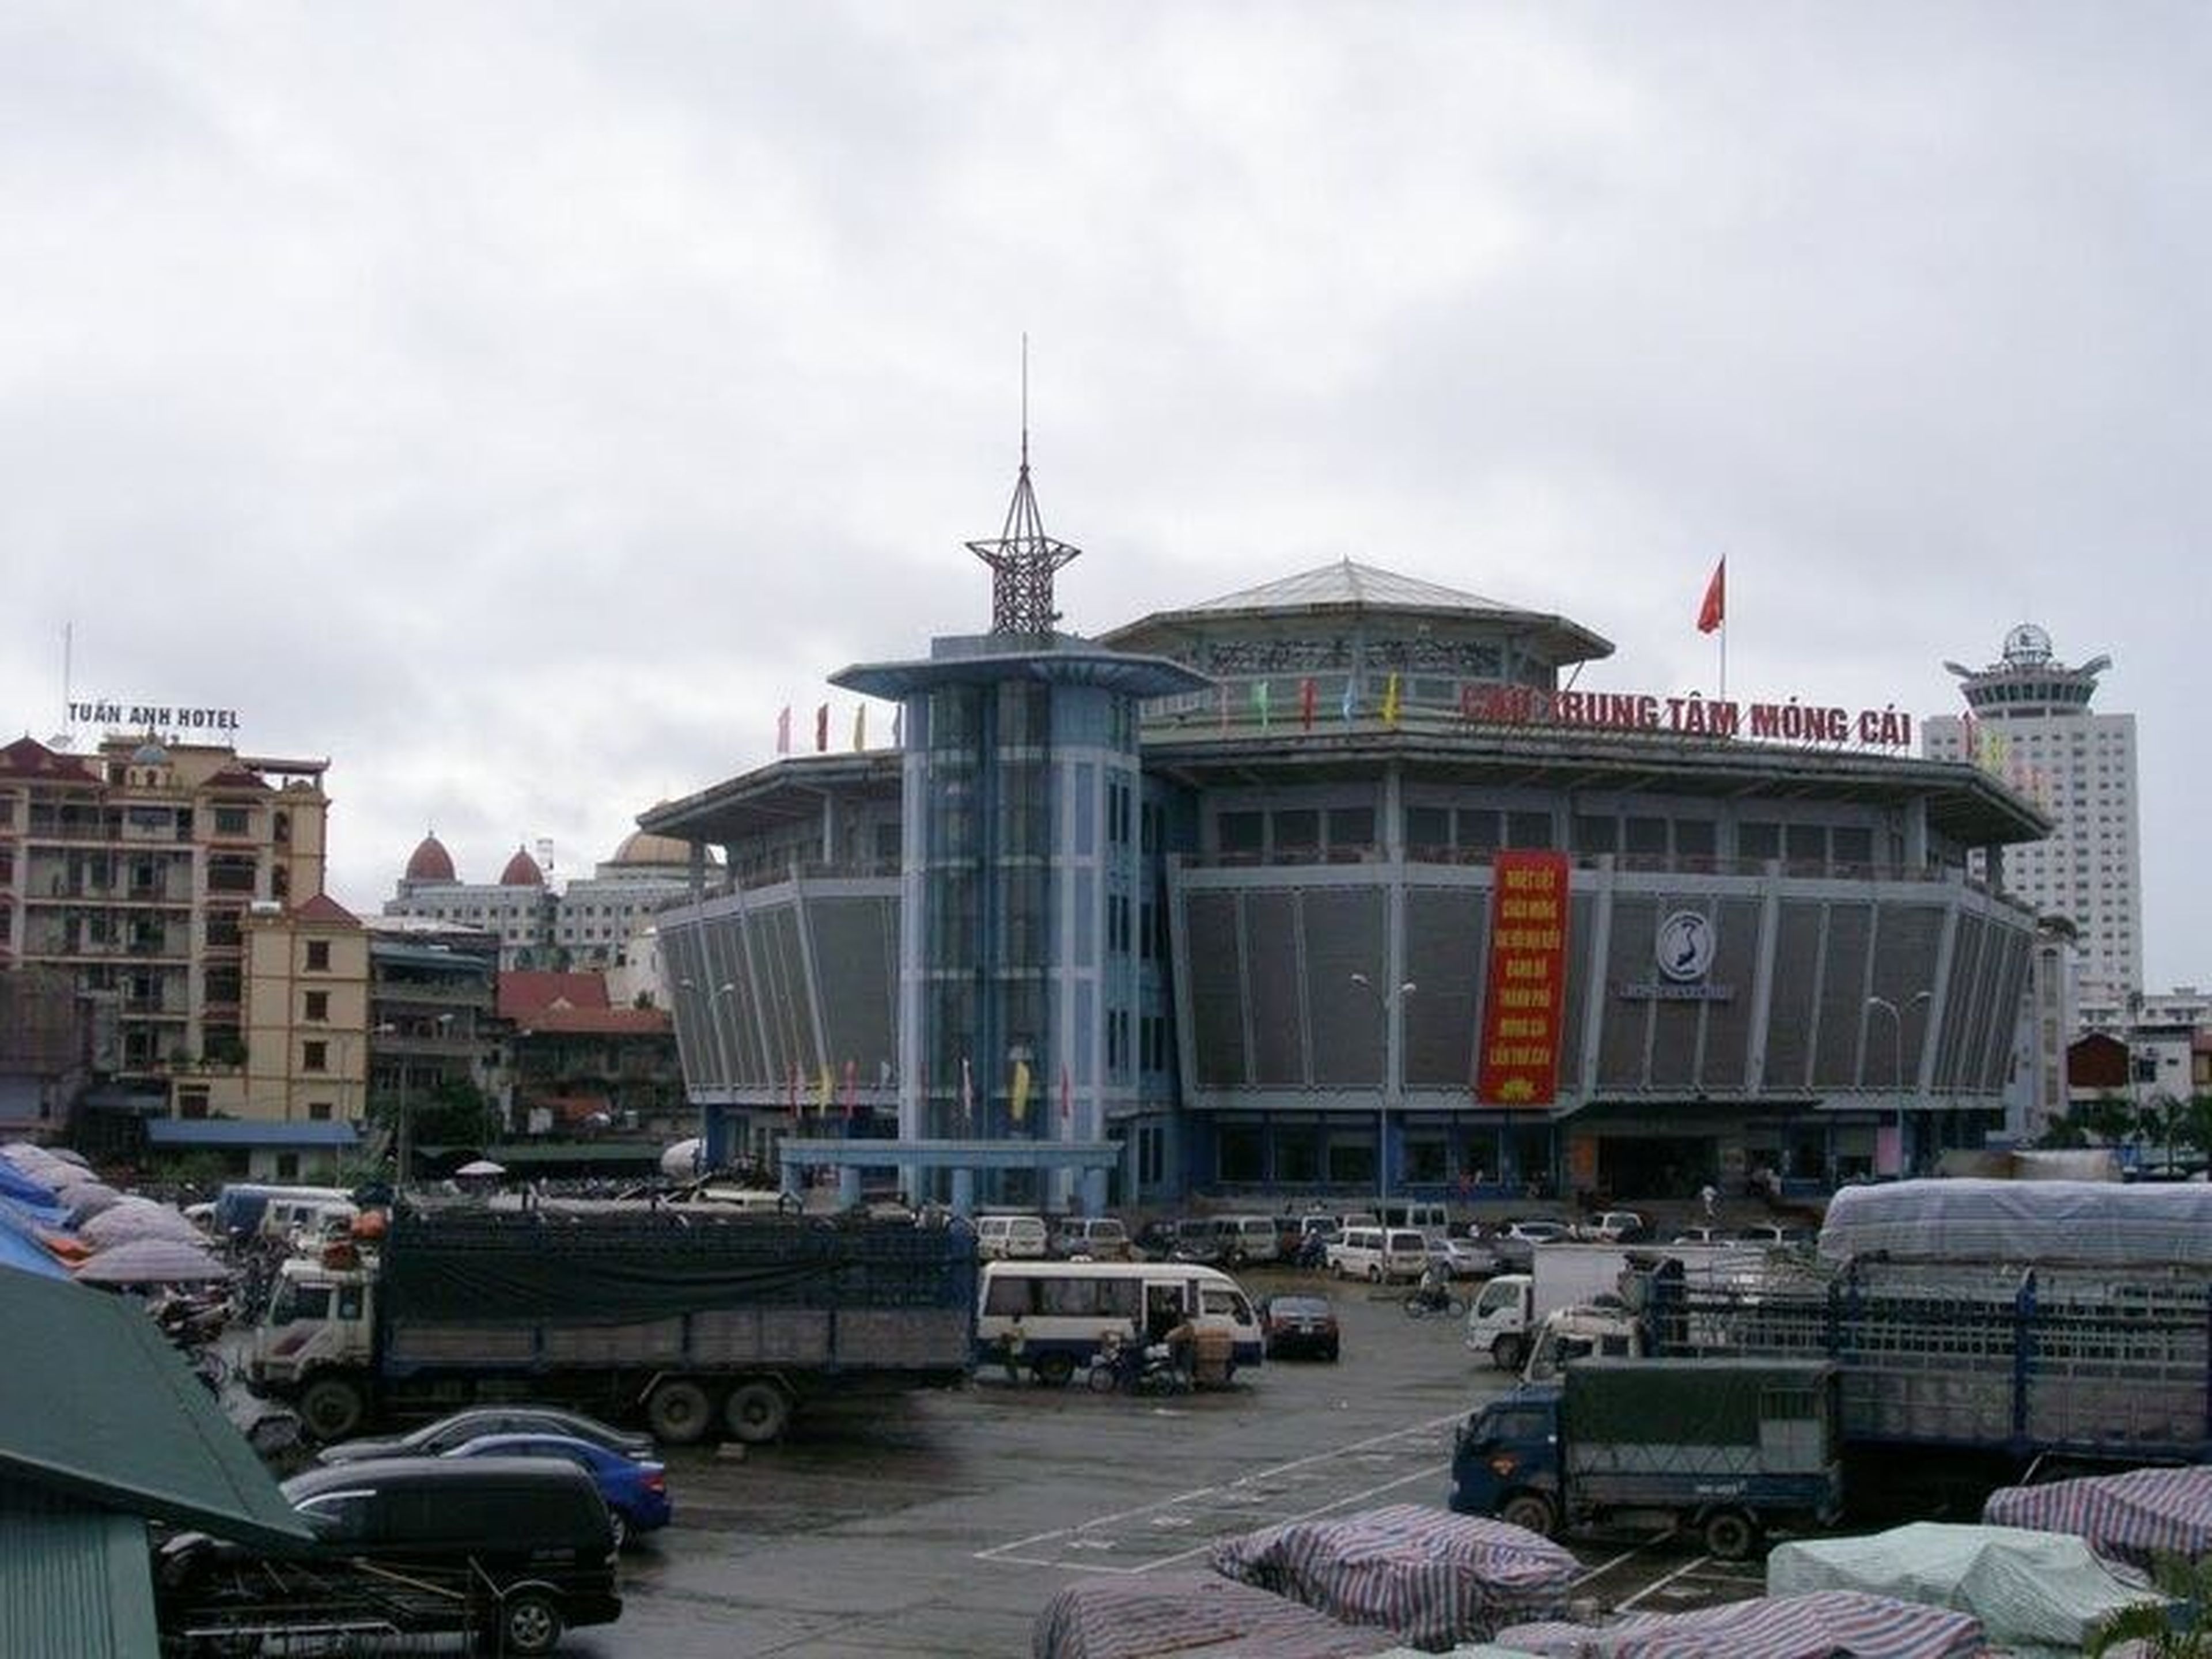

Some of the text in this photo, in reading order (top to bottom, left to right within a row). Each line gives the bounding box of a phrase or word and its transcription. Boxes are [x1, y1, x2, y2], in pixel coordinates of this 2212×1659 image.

[128, 707, 172, 725] ANH
[177, 708, 240, 729] HOTEL
[1666, 691, 1738, 736] TÂM
[1859, 702, 1911, 747] CÁI
